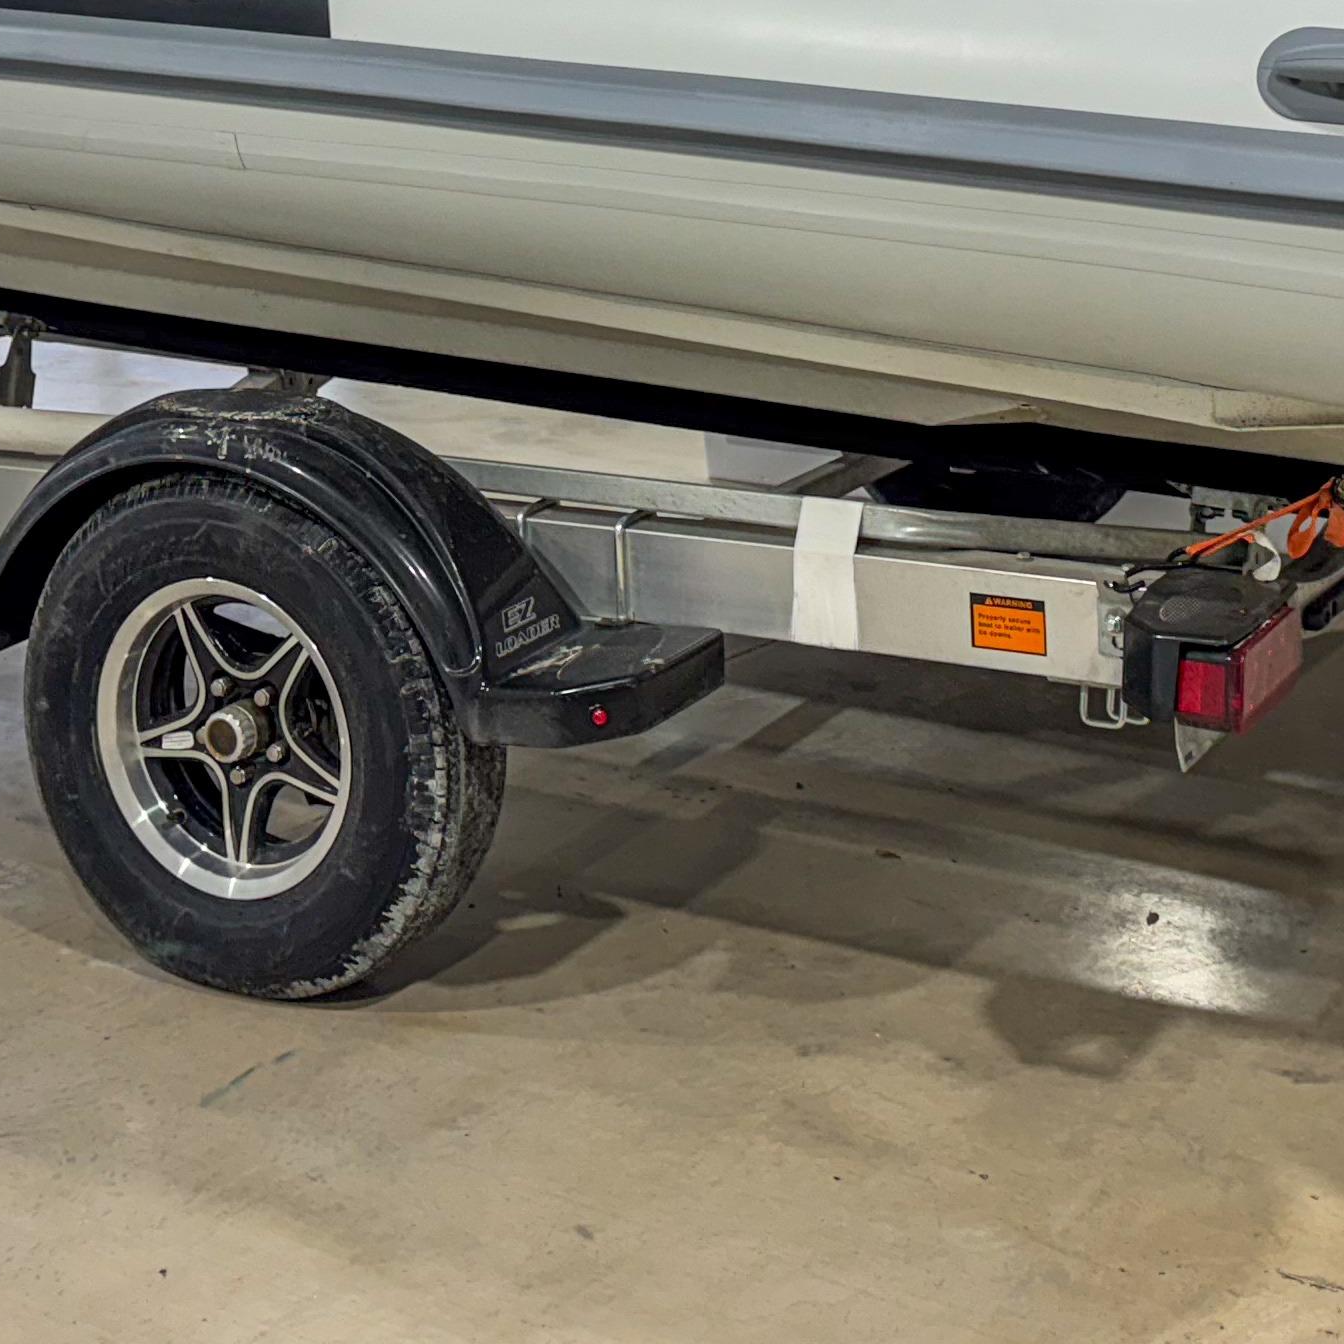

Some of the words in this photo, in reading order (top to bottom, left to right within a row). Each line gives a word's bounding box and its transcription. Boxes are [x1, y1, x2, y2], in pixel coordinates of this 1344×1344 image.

[502, 596, 537, 633] EZ
[992, 597, 1033, 609] WARNING
[496, 613, 561, 658] LOADER
